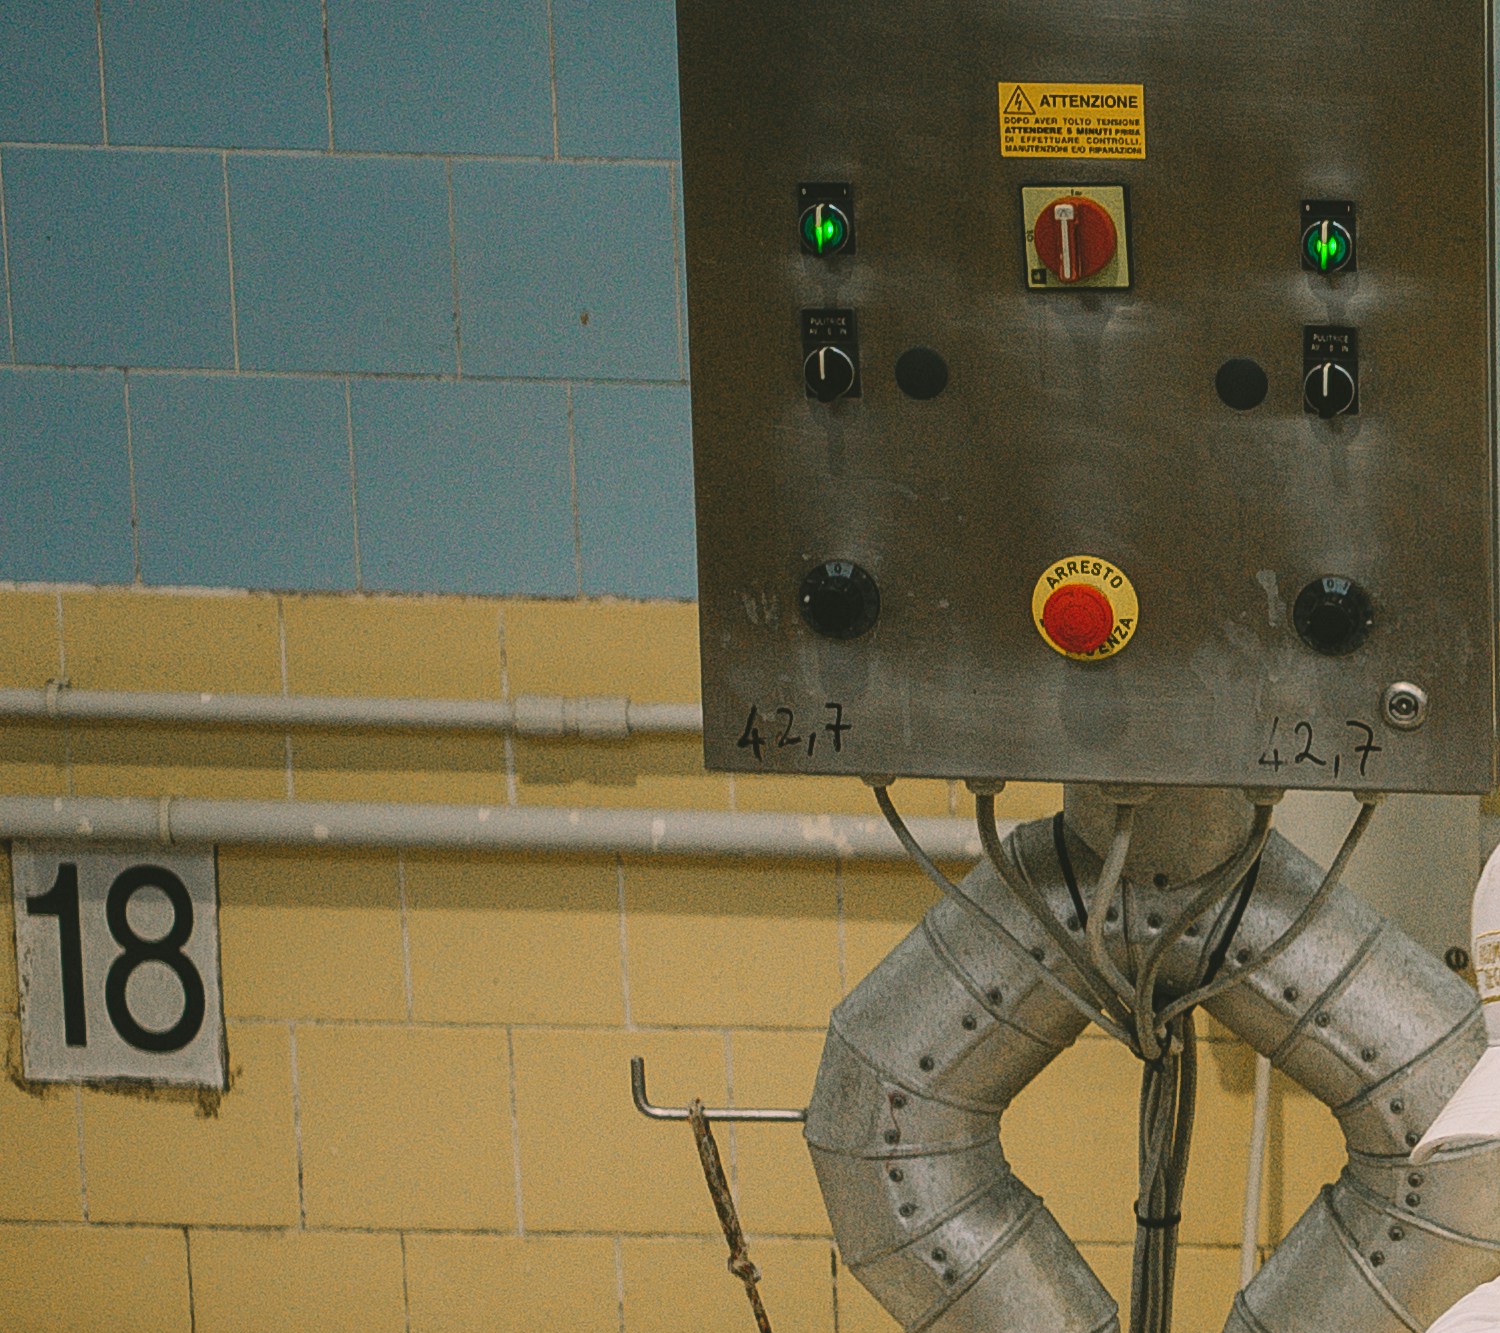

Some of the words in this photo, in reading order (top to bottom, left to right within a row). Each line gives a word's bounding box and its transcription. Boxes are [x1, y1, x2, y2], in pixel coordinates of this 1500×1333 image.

[1040, 94, 1138, 108] ATTENZIONE
[1004, 127, 1062, 135] ATTENDERE
[1076, 128, 1112, 136] MINUTI
[1034, 117, 1058, 125] AVER
[1063, 118, 1092, 126] TOLTO
[1097, 118, 1140, 126] TENSIONE
[1020, 136, 1079, 144] EFFETTUARE
[1046, 560, 1123, 589] ARRESTO
[737, 702, 852, 762] 42,7
[1259, 716, 1382, 778] 42,7
[26, 863, 206, 1054] 18
